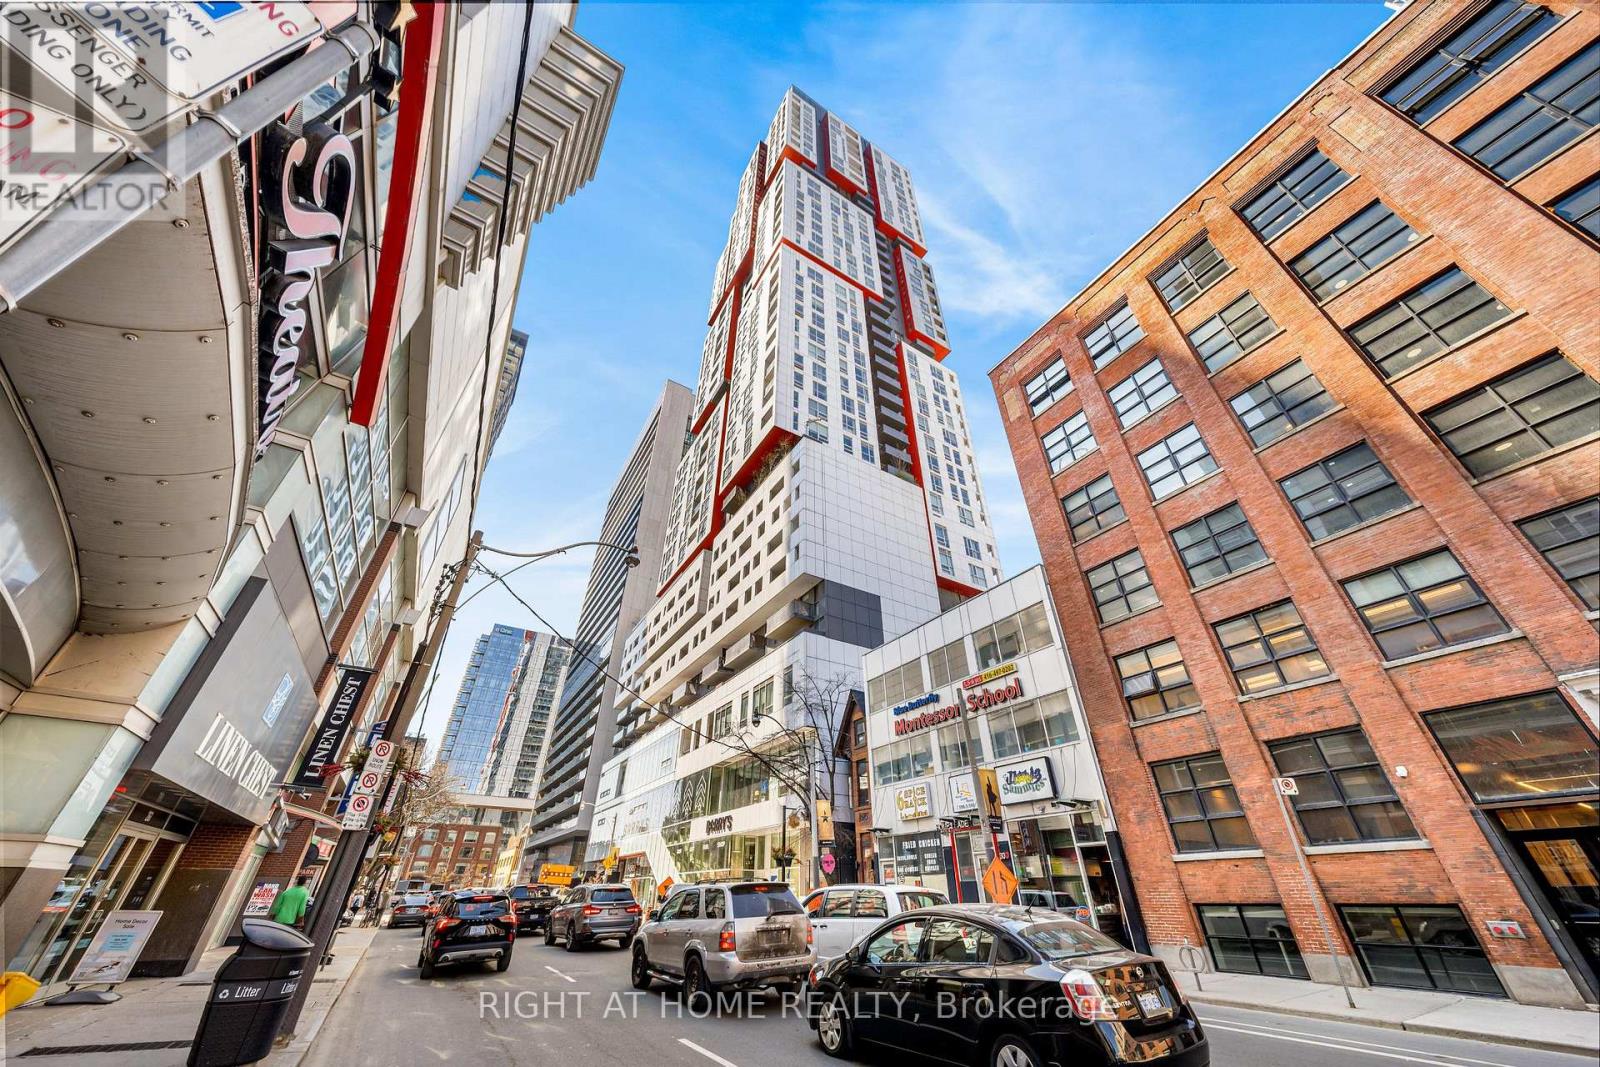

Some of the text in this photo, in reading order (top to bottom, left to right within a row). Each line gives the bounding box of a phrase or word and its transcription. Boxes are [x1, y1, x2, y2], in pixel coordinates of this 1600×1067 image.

[84, 2, 150, 49] ONE
[116, 2, 193, 63] DING
[0, 3, 147, 121] DING ONLY)
[304, 676, 362, 778] LINEN CHEST
[895, 677, 1024, 736] Montessor School
[195, 712, 278, 800] LINEN CHEST
[234, 986, 262, 998] Litter
